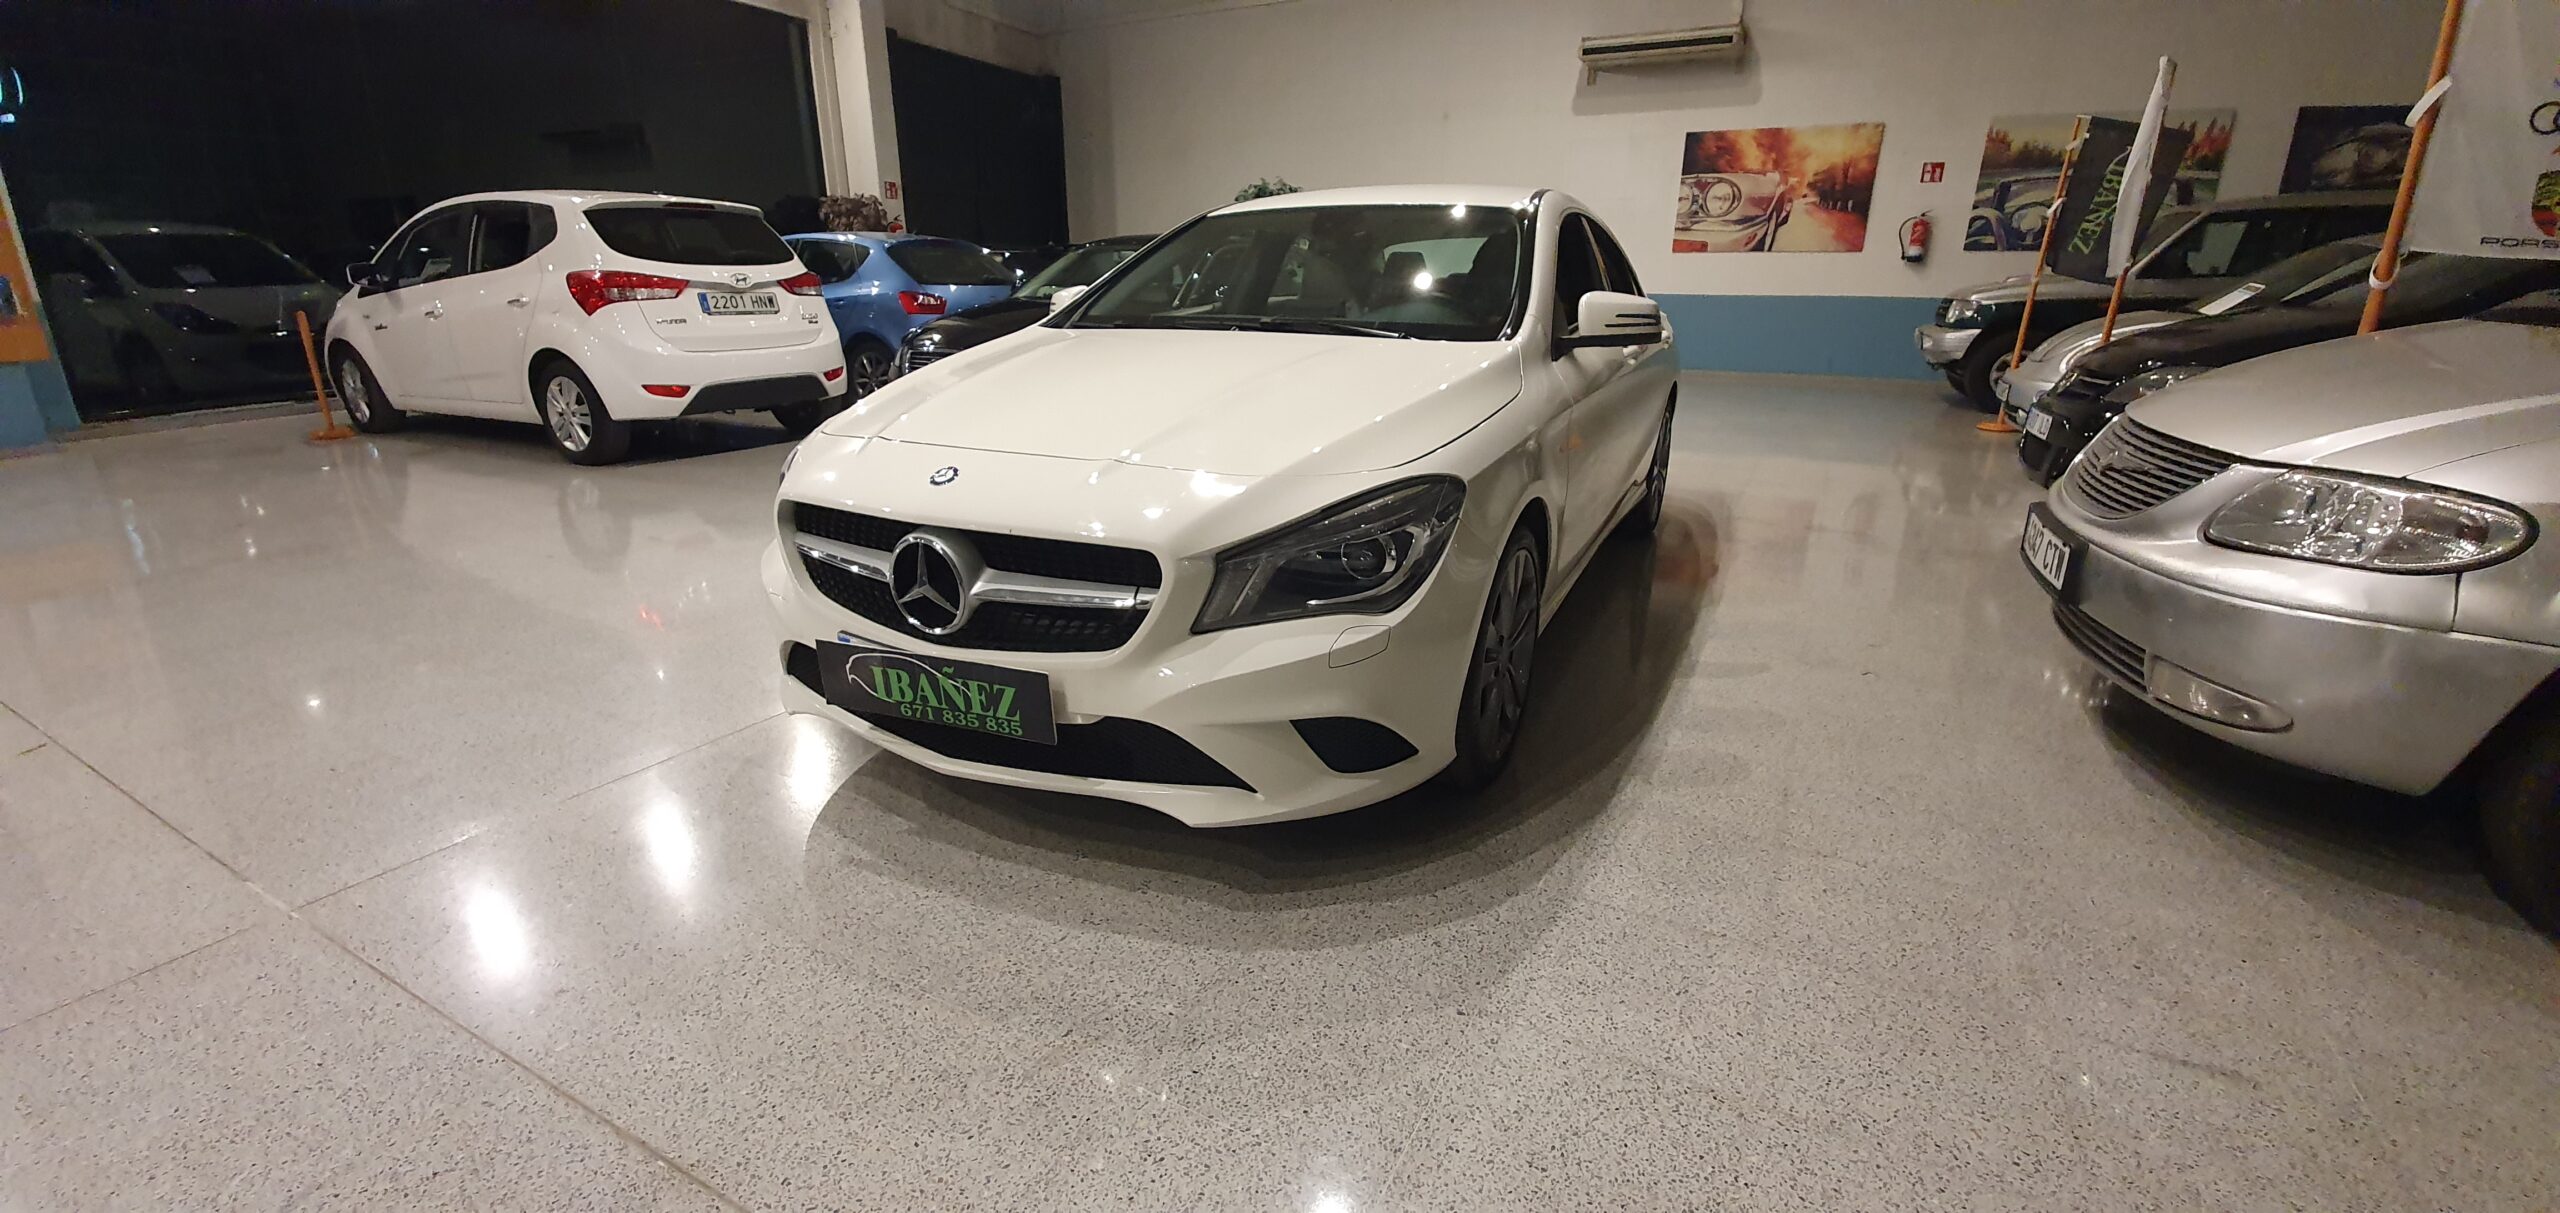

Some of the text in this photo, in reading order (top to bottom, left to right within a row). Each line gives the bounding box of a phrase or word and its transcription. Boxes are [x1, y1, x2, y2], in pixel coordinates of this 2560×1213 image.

[711, 295, 776, 310] 2201 HNW
[869, 665, 1021, 721] IBAÑEZ
[900, 703, 1023, 737] 671 835 835
